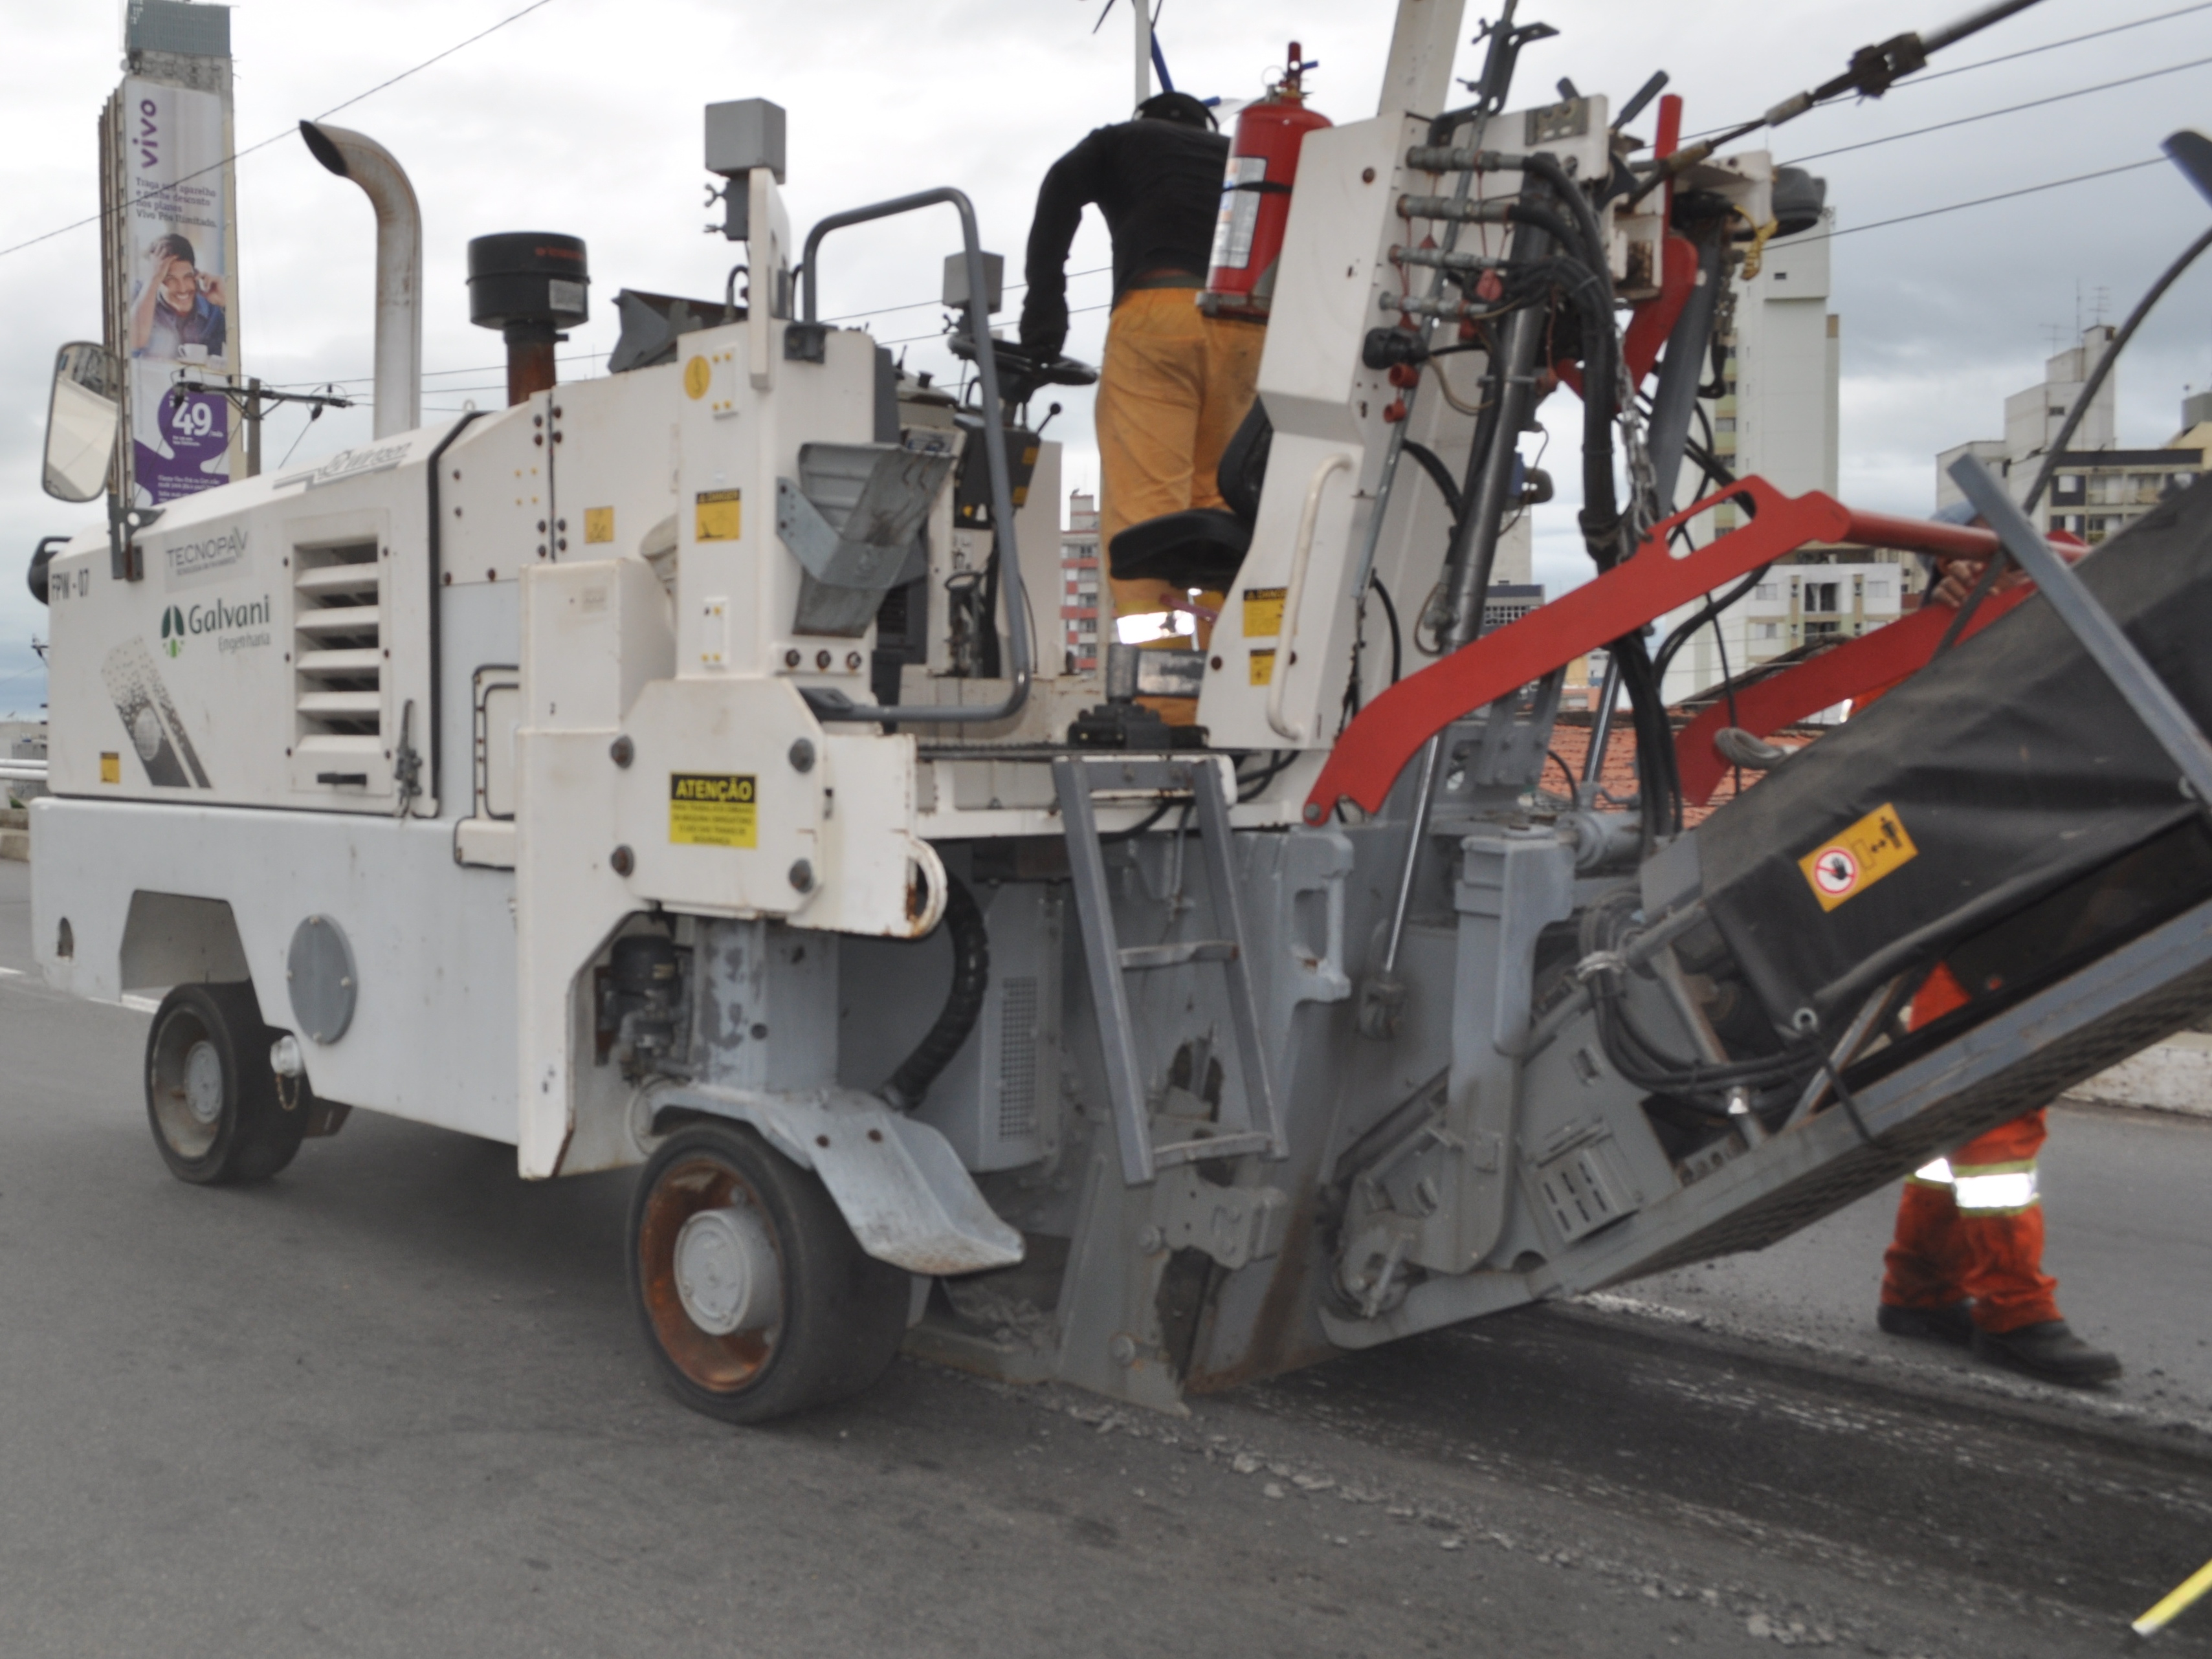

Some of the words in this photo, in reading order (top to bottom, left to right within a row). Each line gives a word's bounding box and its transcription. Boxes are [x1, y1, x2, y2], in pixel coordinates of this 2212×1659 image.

[133, 100, 159, 168] vivo
[135, 177, 159, 190] Traga
[179, 185, 217, 197] aparelho
[173, 194, 211, 206] desconto
[136, 208, 155, 219] Vivo
[154, 201, 182, 213] planos
[172, 402, 213, 436] 49
[166, 525, 249, 568] TECNOPAV
[78, 567, 89, 598] 07
[188, 595, 270, 635] Galvani
[218, 632, 271, 654] Engenharia
[675, 776, 753, 802] ATENÇÃO
